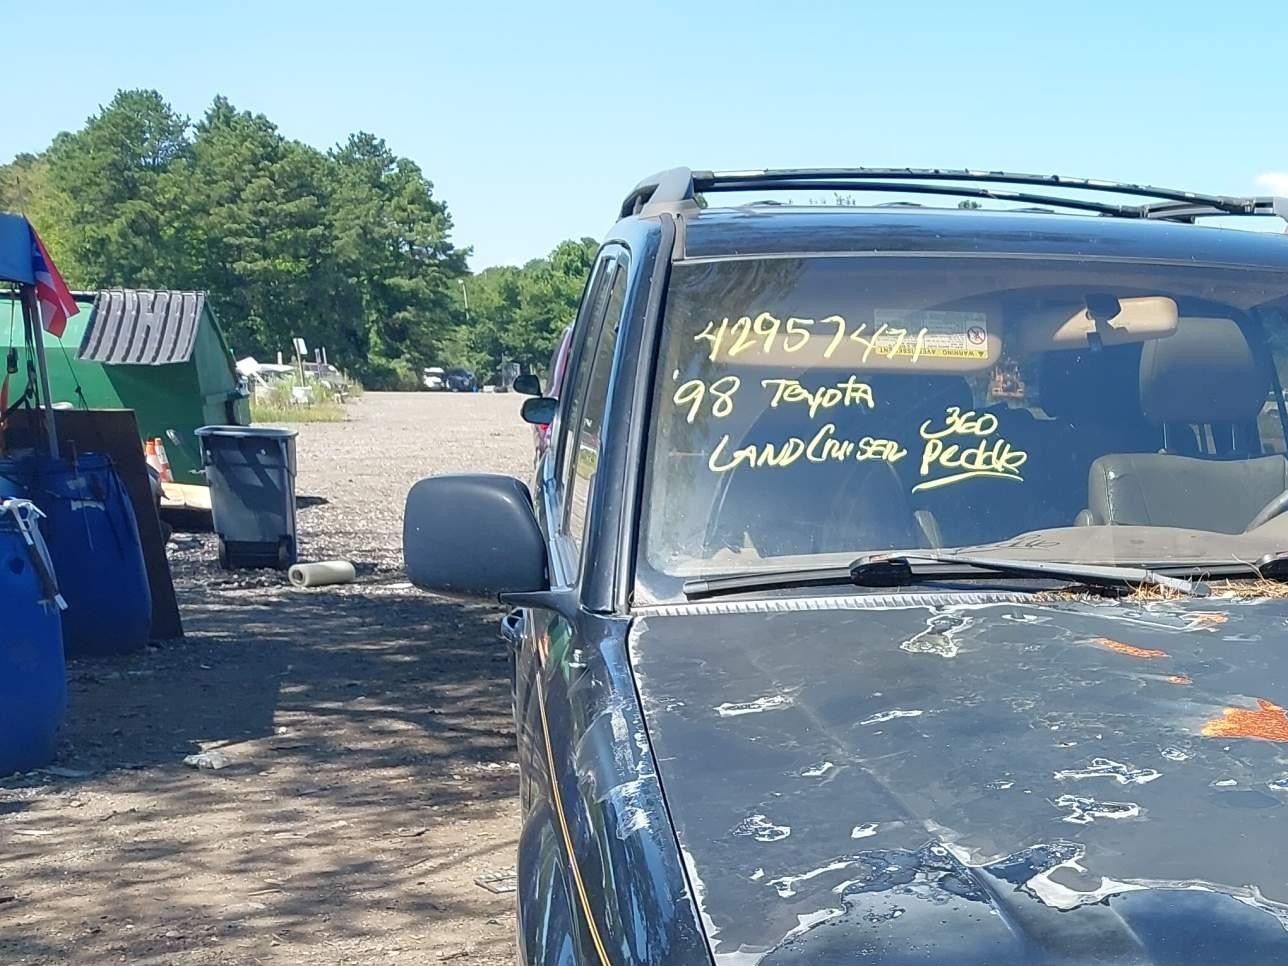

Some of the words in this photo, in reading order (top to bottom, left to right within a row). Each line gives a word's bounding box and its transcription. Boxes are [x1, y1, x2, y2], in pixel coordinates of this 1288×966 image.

[694, 311, 929, 363] 42957471
[942, 349, 975, 357] WARNING
[920, 407, 998, 439] 360
